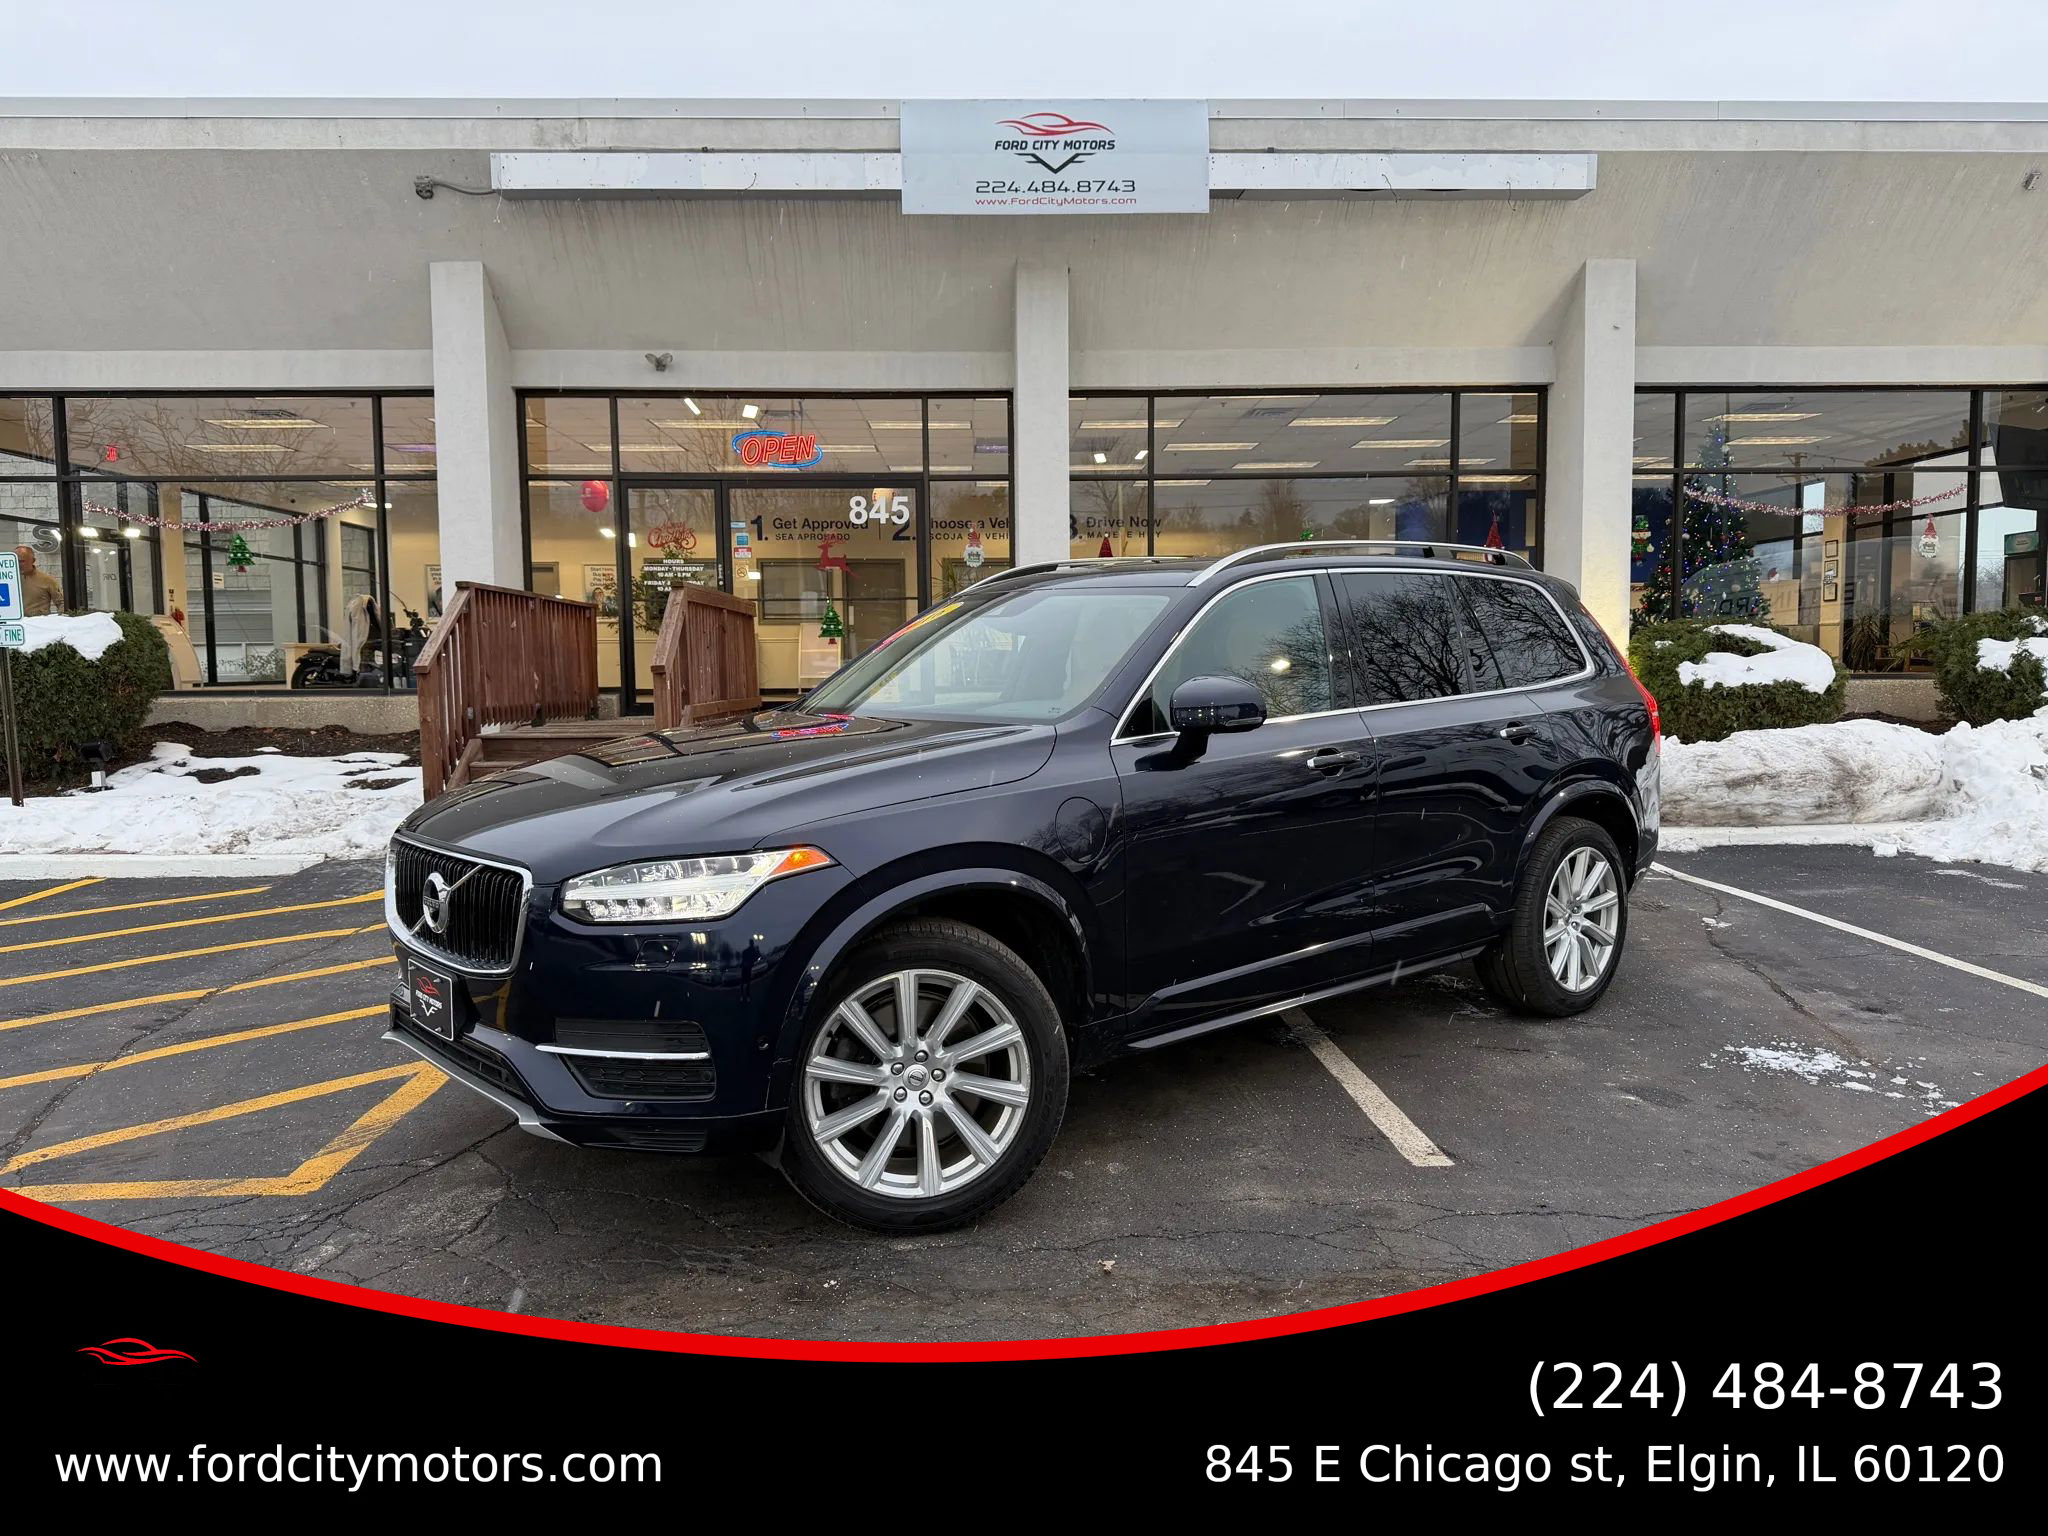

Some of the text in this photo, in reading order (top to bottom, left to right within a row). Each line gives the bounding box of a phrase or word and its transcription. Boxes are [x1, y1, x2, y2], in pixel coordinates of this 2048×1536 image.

[995, 140, 1116, 151] FORD CITY MOTORS
[975, 180, 1136, 194] 224.484.8743
[975, 196, 1137, 206] www.FordCityMotors.com
[742, 434, 815, 465] OPEN
[849, 495, 910, 524] 845
[750, 515, 868, 541] 1. Get Approved
[931, 517, 973, 529] hoose
[977, 519, 985, 529] a
[1086, 516, 1125, 528] Drive
[1129, 516, 1162, 528] Now
[775, 533, 794, 541] SEA
[929, 532, 963, 540] SCOJA
[1139, 531, 1161, 539] HY
[4, 628, 23, 641] FINE
